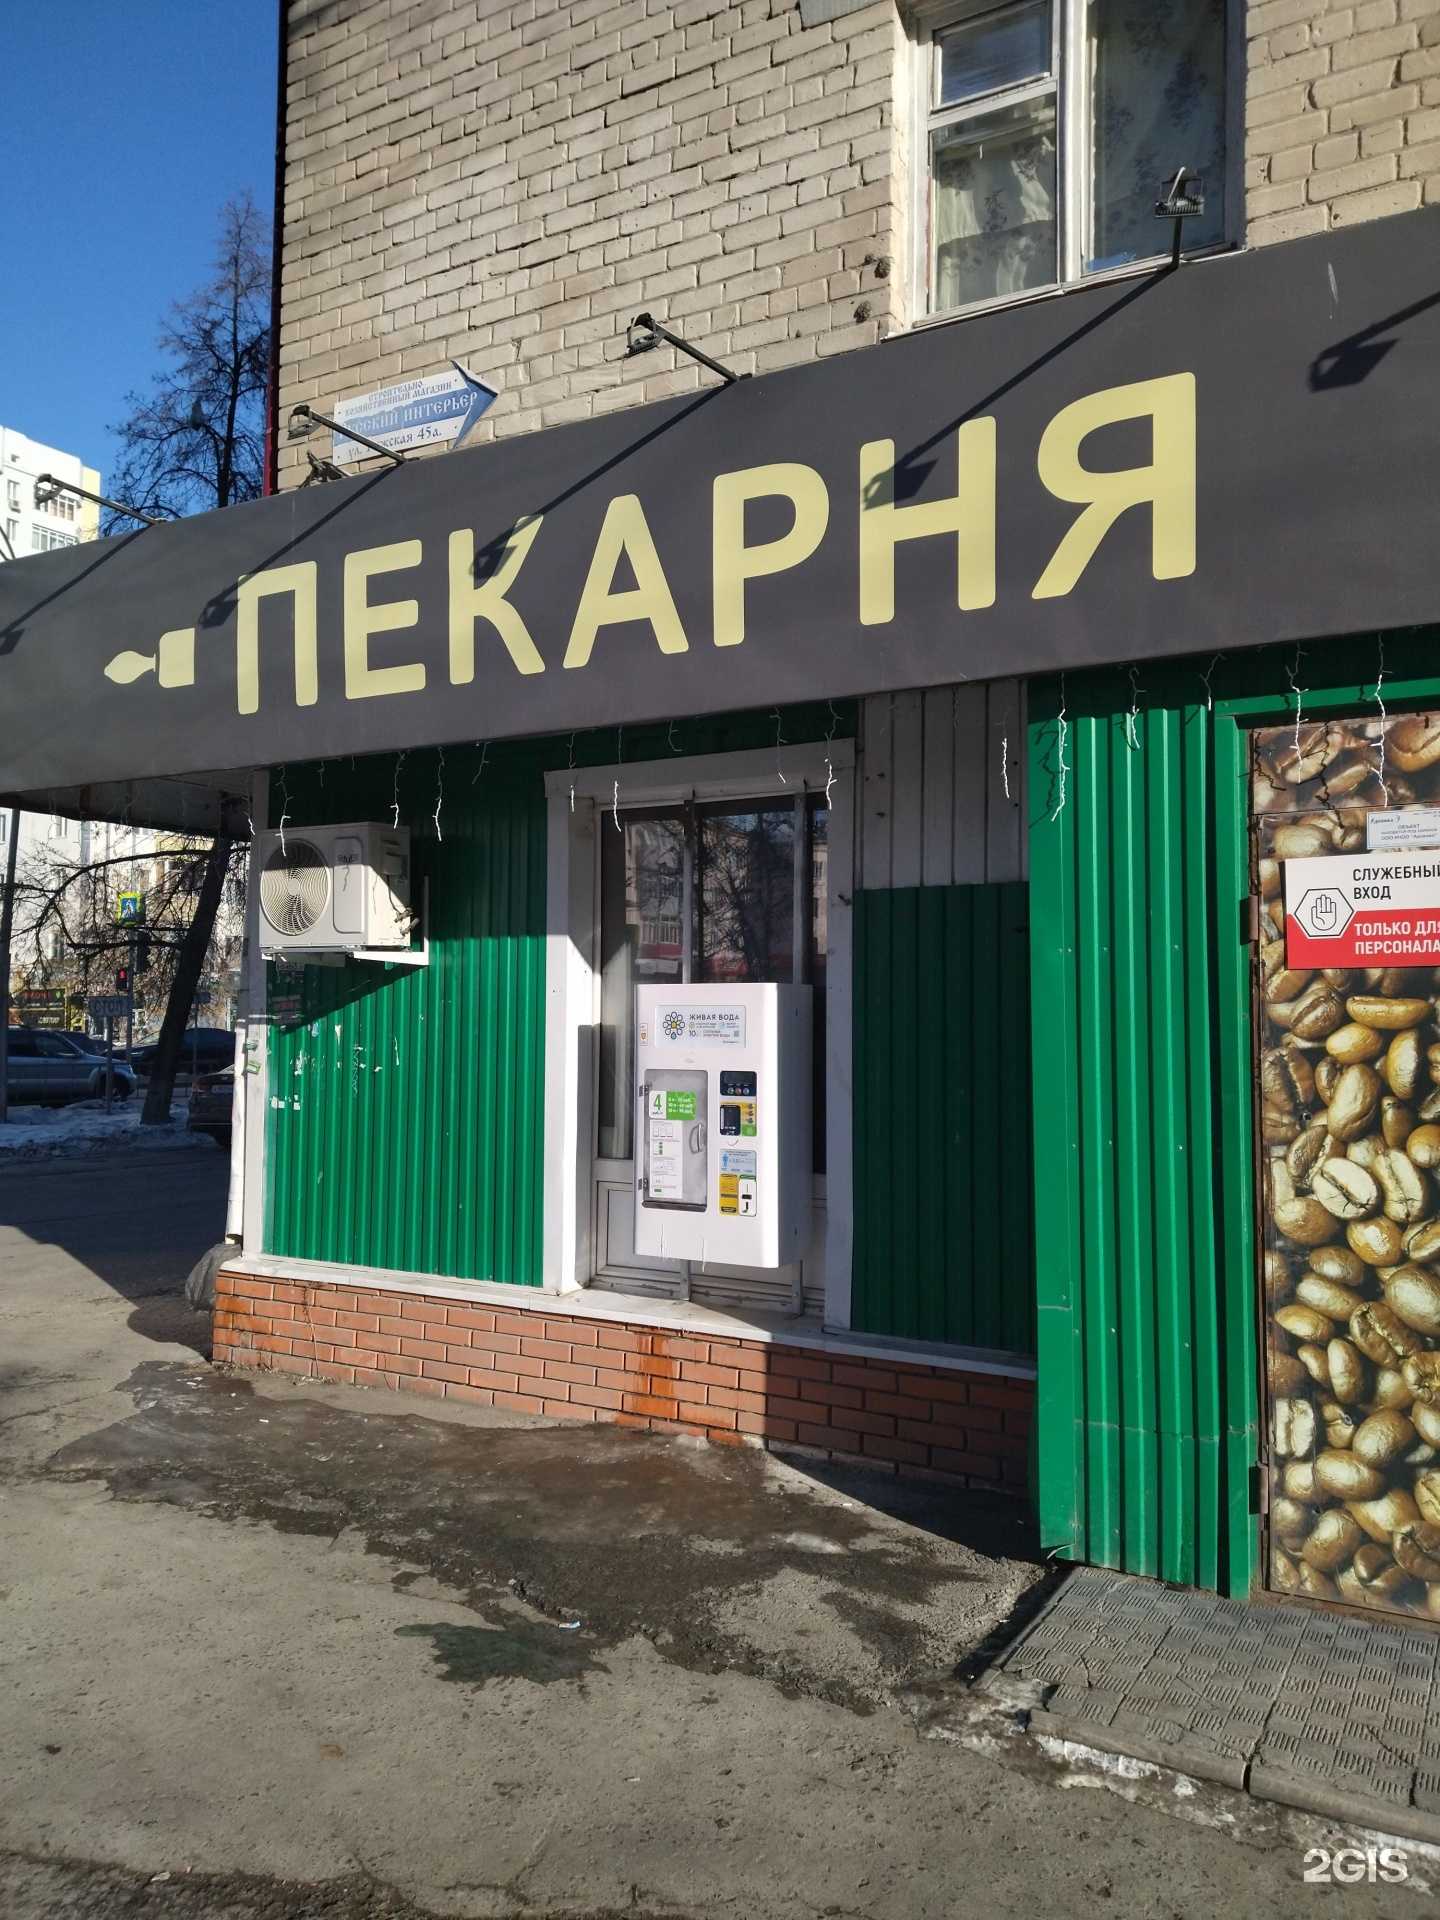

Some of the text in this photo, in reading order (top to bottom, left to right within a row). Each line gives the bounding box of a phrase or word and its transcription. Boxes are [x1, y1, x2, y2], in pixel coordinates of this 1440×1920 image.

[404, 391, 478, 421] ИНТЕРЬЕР
[236, 371, 1198, 716] ПЕКАРНЯ
[1352, 861, 1440, 881] СЛУЖЕБНЫ
[1353, 885, 1392, 900] ВХОД
[1354, 921, 1412, 937] ТОЛЬКО
[1355, 939, 1440, 955] ПЕРСОНАЛА
[689, 1013, 740, 1021] ЖИВАЯ ВОДА
[653, 1093, 662, 1110] 4
